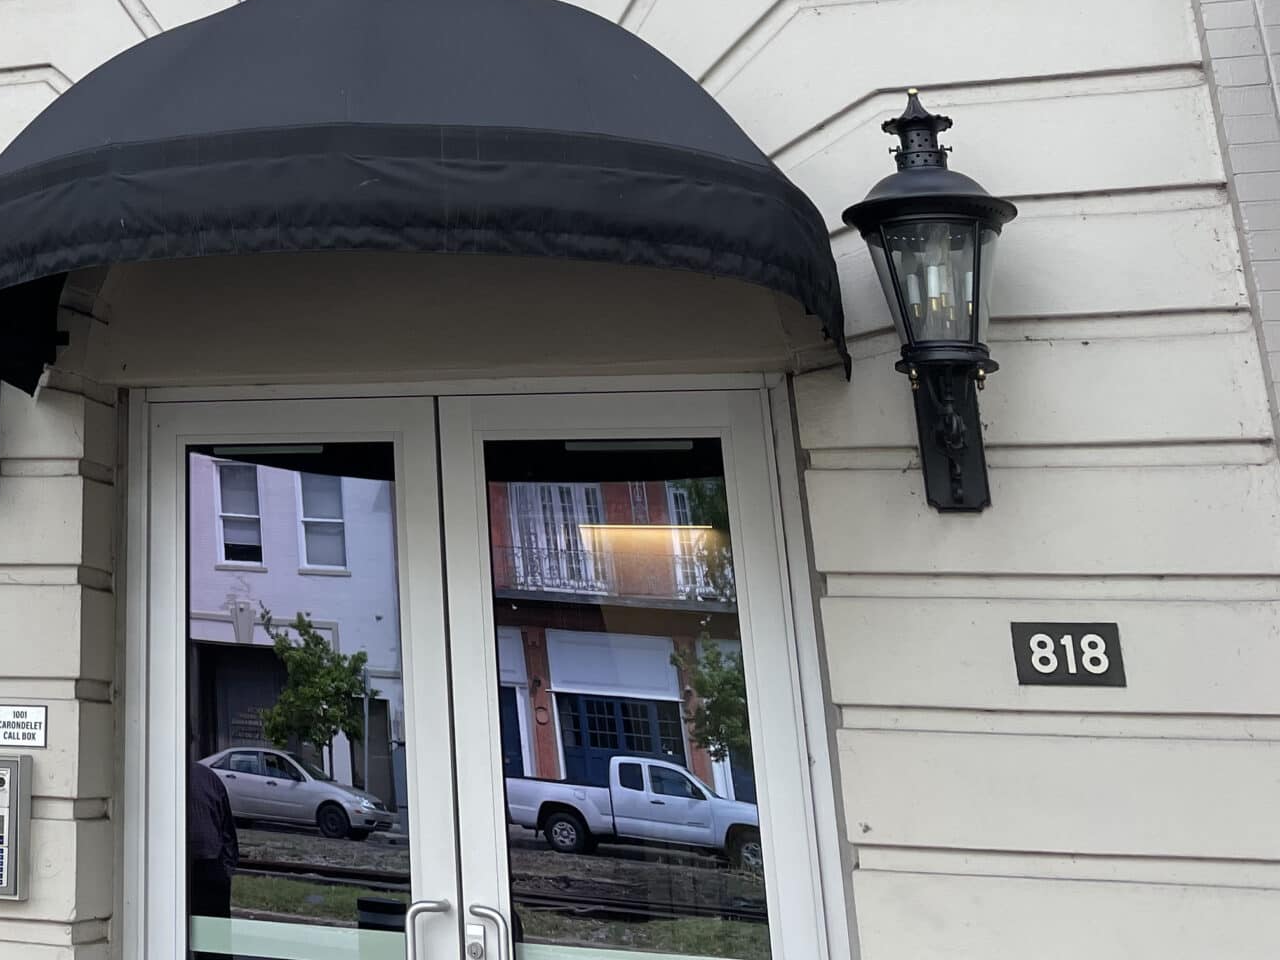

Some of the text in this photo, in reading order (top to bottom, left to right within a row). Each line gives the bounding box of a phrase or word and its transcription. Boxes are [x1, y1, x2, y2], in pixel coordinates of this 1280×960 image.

[1029, 633, 1109, 674] 818
[13, 710, 27, 719] 1001
[3, 731, 36, 741] CALL BOX
